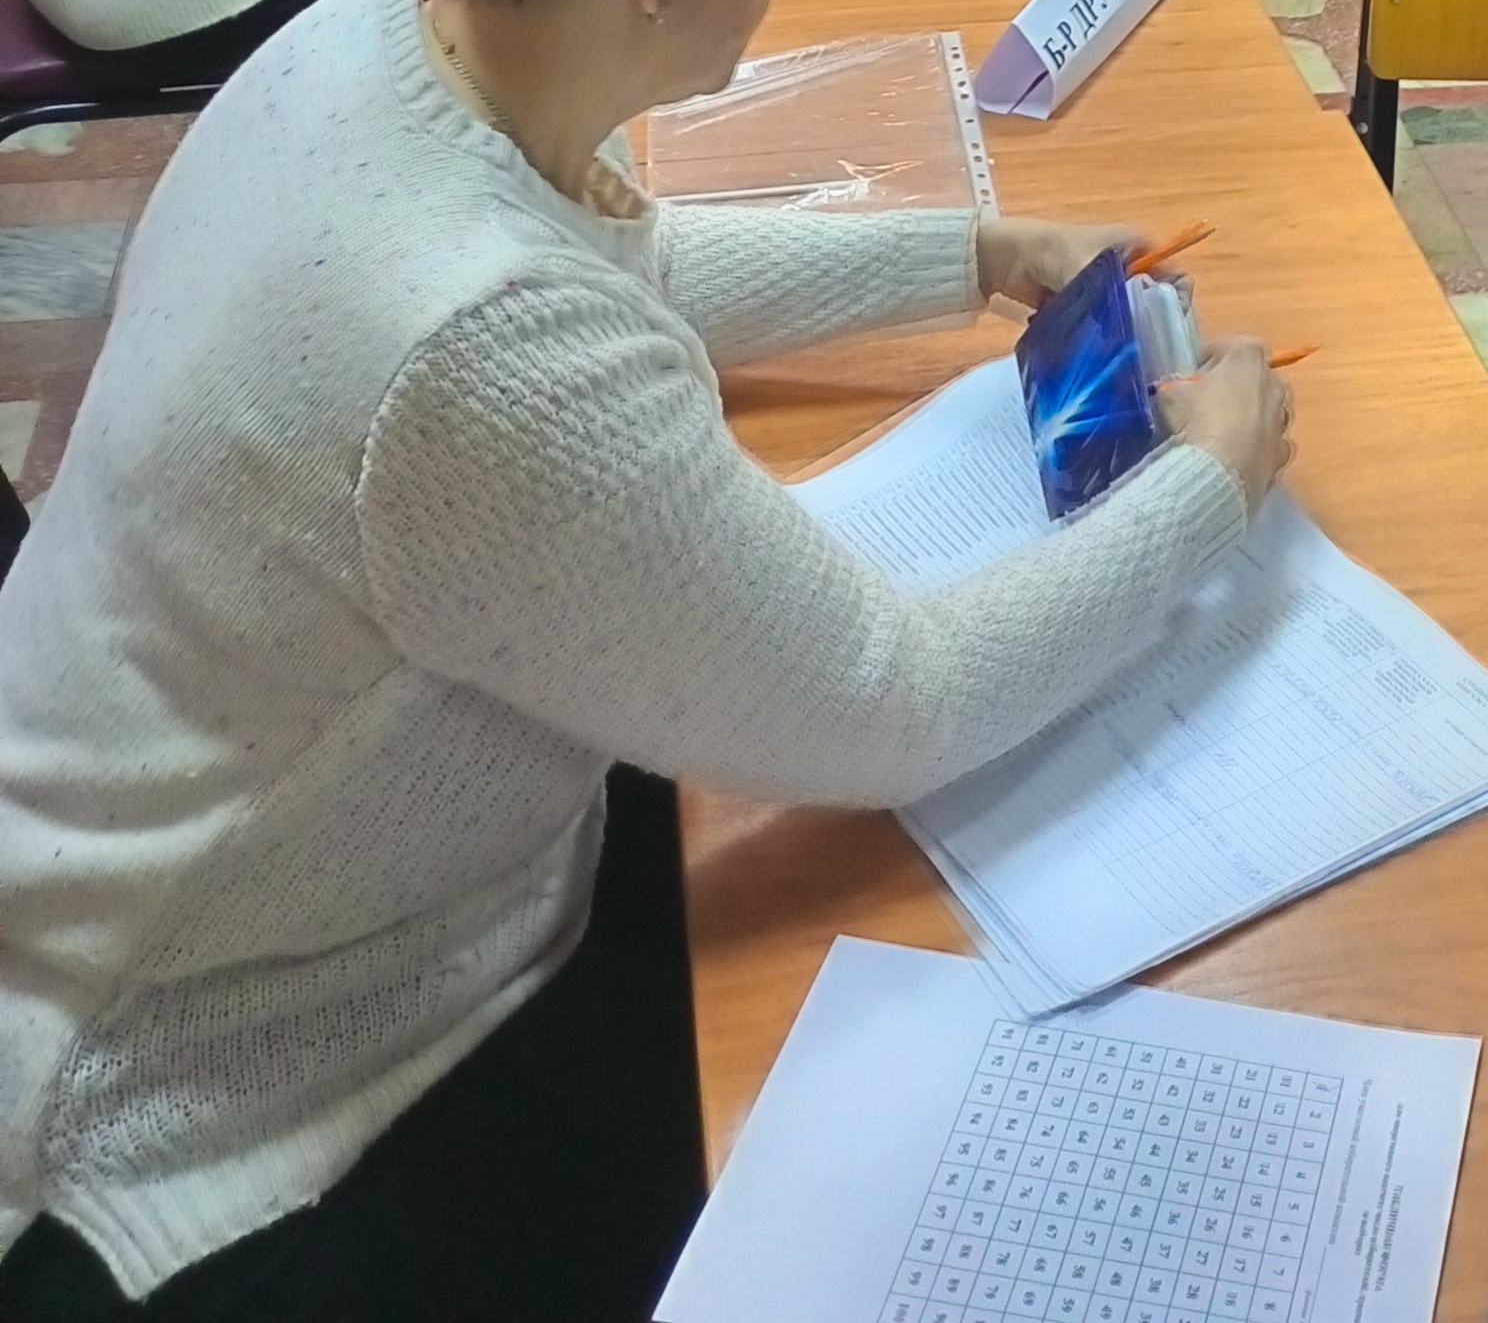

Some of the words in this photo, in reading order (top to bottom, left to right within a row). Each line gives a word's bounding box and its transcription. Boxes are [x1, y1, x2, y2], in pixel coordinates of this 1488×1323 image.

[1042, 21, 1077, 71] Б-Р
[1001, 1027, 1016, 1040] 91
[1036, 1034, 1050, 1046] 81
[1070, 1040, 1085, 1052] 71
[1104, 1045, 1117, 1058] 61
[991, 1054, 1005, 1067] 92
[1140, 1052, 1154, 1064] 51
[1175, 1056, 1187, 1069] 41
[1025, 1060, 1040, 1073] 82
[1060, 1066, 1076, 1079] 72
[1209, 1063, 1224, 1076] 31
[1095, 1072, 1109, 1085] 62
[1244, 1068, 1258, 1082] 21
[1279, 1075, 1294, 1088] 11
[980, 1083, 994, 1096] 93
[1131, 1078, 1145, 1092] 52
[1166, 1084, 1179, 1097] 42
[1016, 1089, 1029, 1102] 83
[1050, 1095, 1066, 1109] 73
[1201, 1090, 1216, 1104] 32
[1086, 1101, 1099, 1114] 63
[1237, 1096, 1251, 1110] 22
[1272, 1102, 1286, 1116] 12
[969, 1112, 983, 1125] 94
[1122, 1107, 1136, 1121] 53
[1158, 1113, 1171, 1127] 43
[1309, 1110, 1322, 1120] 2
[1004, 1118, 1019, 1131] 84
[1040, 1124, 1055, 1137] 74
[1193, 1119, 1208, 1133] 33
[1076, 1130, 1089, 1144] 64
[1229, 1125, 1243, 1140] 23
[1265, 1132, 1279, 1146] 13
[957, 1142, 972, 1156] 95
[1112, 1137, 1127, 1151] 54
[1148, 1143, 1161, 1157] 44
[1302, 1141, 1315, 1149] 3
[993, 1148, 1008, 1162] 85
[1029, 1155, 1045, 1169] 75
[1185, 1150, 1199, 1164] 34
[1066, 1160, 1080, 1174] 65
[1221, 1155, 1235, 1170] 24
[1257, 1163, 1270, 1176] 14
[945, 1172, 960, 1187] 96
[1102, 1167, 1117, 1181] 55
[1139, 1173, 1152, 1188] 45
[1295, 1171, 1306, 1180] 4
[982, 1178, 996, 1193] 86
[1018, 1186, 1034, 1199] 76
[1176, 1180, 1190, 1195] 35
[1055, 1191, 1069, 1206] 66
[1212, 1186, 1227, 1202] 25
[1249, 1194, 1263, 1208] 15
[1093, 1197, 1107, 1212] 56
[1129, 1204, 1143, 1219] 46
[1287, 1202, 1300, 1211] 5
[934, 1204, 948, 1220] 97
[972, 1211, 985, 1227] 87
[1167, 1211, 1182, 1225] 36
[1008, 1218, 1023, 1233] 77
[1203, 1217, 1218, 1232] 26
[1045, 1224, 1058, 1240] 67
[1083, 1230, 1097, 1247] 57
[1241, 1225, 1255, 1240] 16
[1280, 1234, 1291, 1243] 6
[920, 1237, 935, 1252] 98
[958, 1244, 973, 1259] 88
[1121, 1236, 1134, 1253] 47
[1158, 1242, 1172, 1260] 37
[996, 1252, 1011, 1266] 78
[1033, 1257, 1047, 1272] 68
[1195, 1249, 1210, 1267] 27
[1071, 1264, 1087, 1280] 58
[1233, 1258, 1247, 1274] 17
[1273, 1268, 1285, 1277] 7
[908, 1271, 923, 1286] 99
[946, 1278, 961, 1293] 89
[1109, 1271, 1123, 1287] 48
[984, 1285, 1000, 1300] 79
[1147, 1278, 1163, 1294] 38
[1186, 1284, 1201, 1300] 28
[1022, 1291, 1036, 1307] 69
[1061, 1298, 1076, 1314] 59
[1224, 1292, 1238, 1307] 18
[1100, 1304, 1113, 1320] 49
[1264, 1302, 1276, 1311] 8
